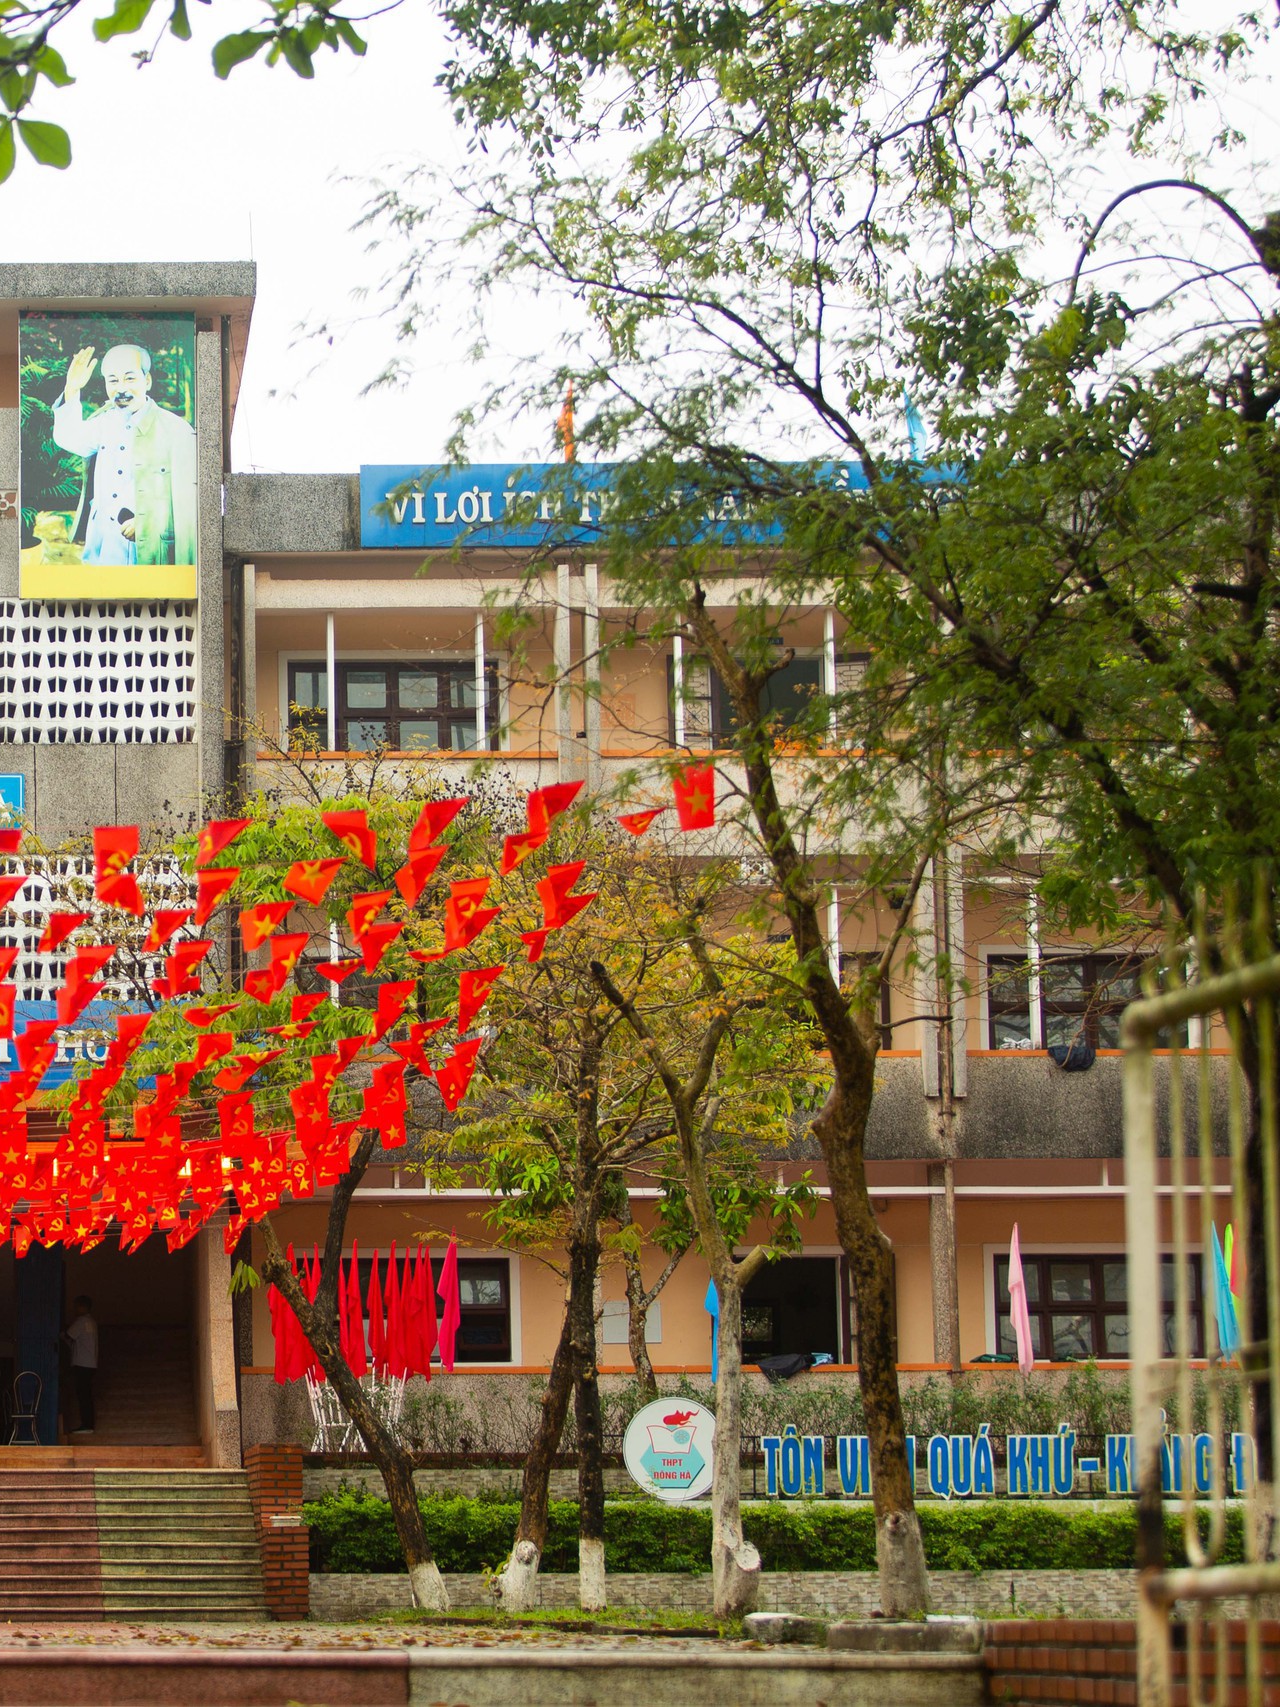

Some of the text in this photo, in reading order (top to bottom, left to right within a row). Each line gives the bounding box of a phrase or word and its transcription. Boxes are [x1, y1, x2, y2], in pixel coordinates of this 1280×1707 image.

[385, 480, 426, 523] VÌ
[661, 1458, 683, 1467] THPT
[760, 1424, 826, 1496] TÔN
[927, 1423, 996, 1500] QUÁ
[1006, 1423, 1077, 1495] KHỨ
